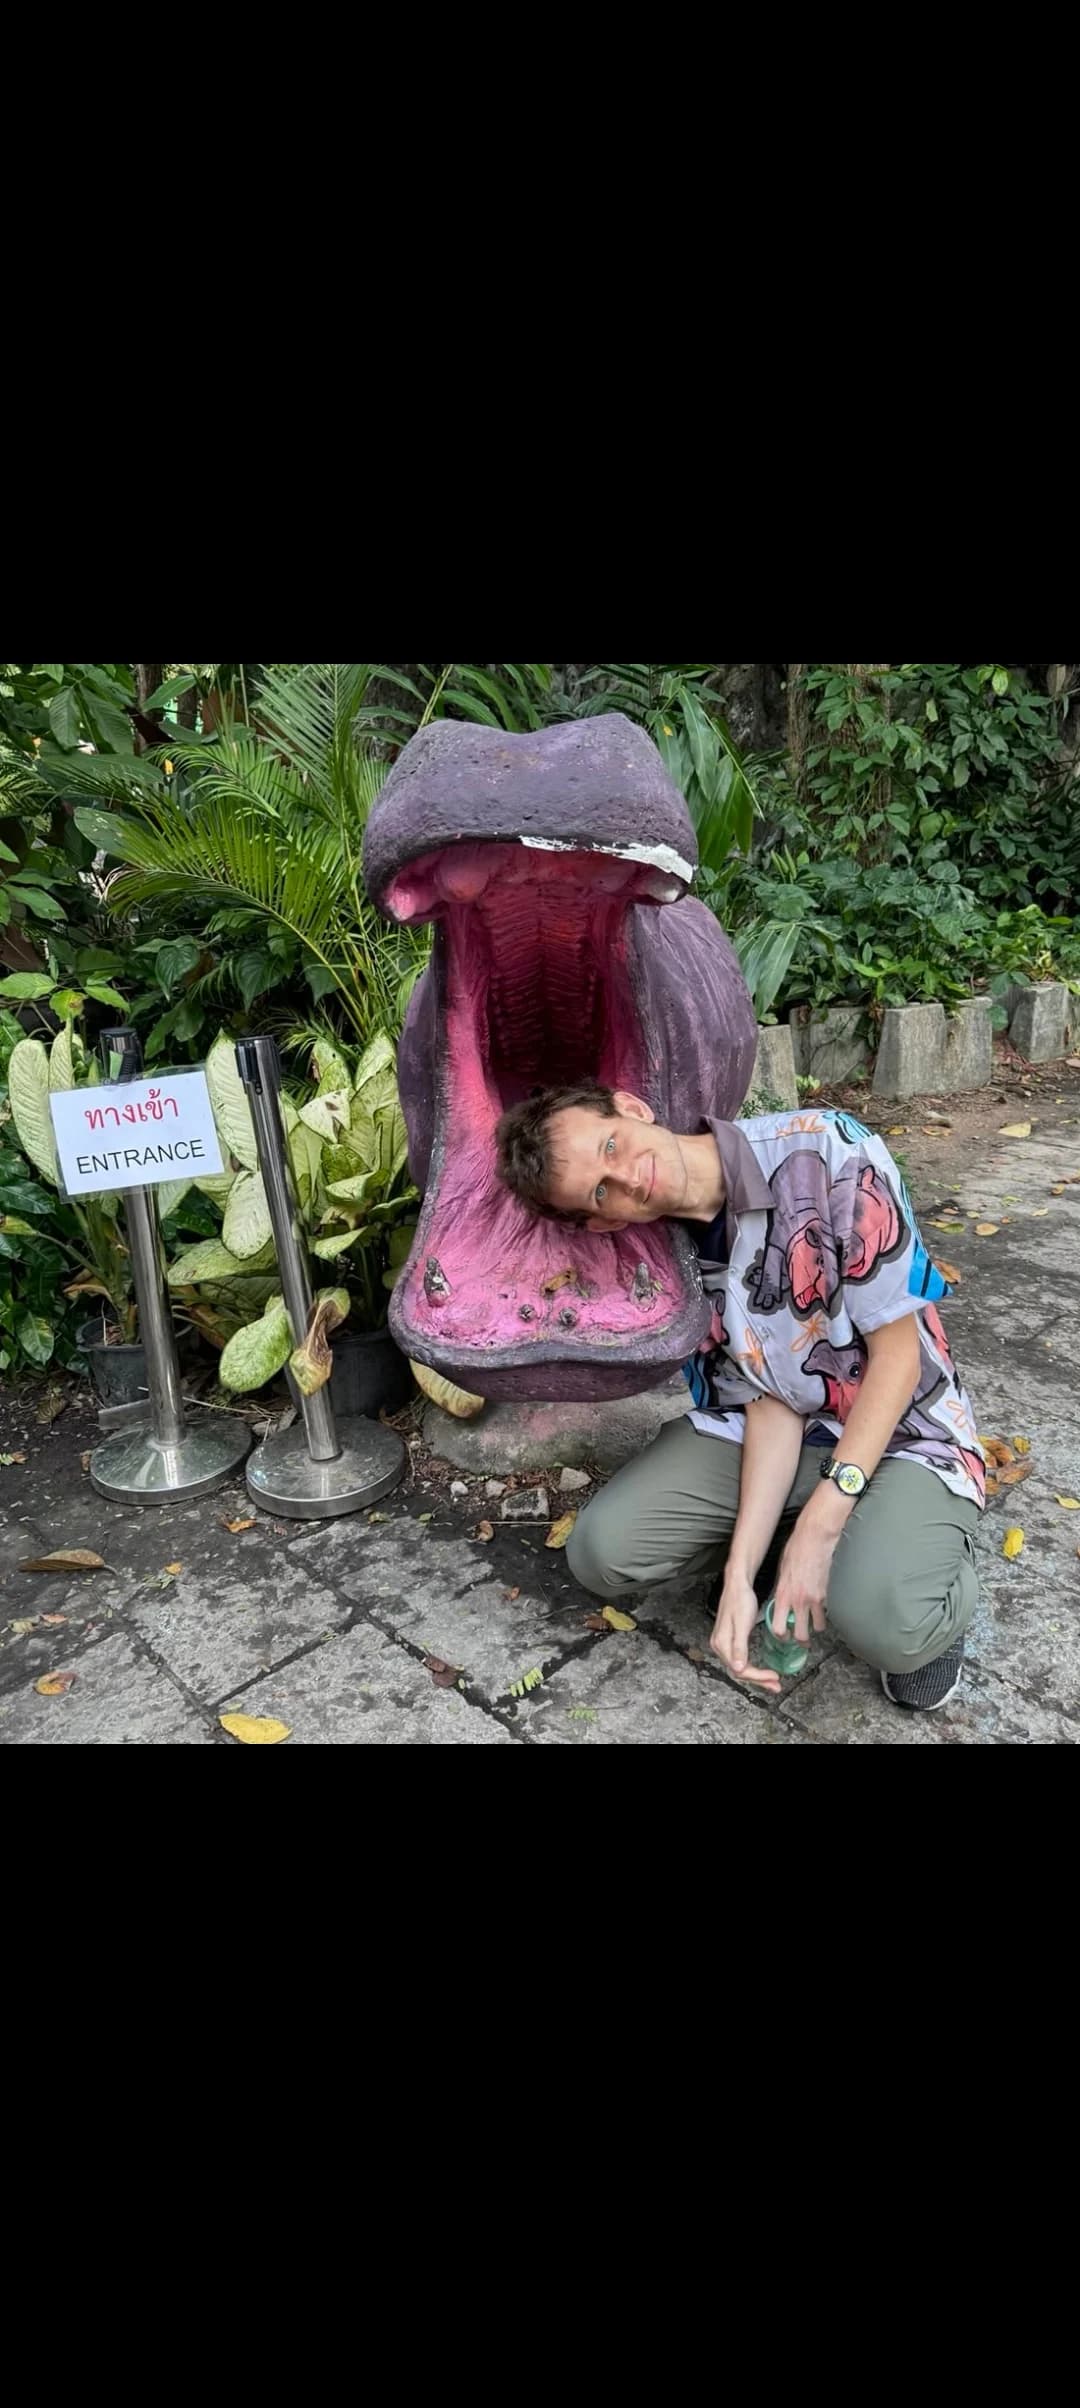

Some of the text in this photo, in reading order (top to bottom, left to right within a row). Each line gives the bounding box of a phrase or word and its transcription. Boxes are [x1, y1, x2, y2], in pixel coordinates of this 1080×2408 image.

[84, 1088, 179, 1130] ทางเข้า
[76, 1139, 205, 1175] ENTRANCE
